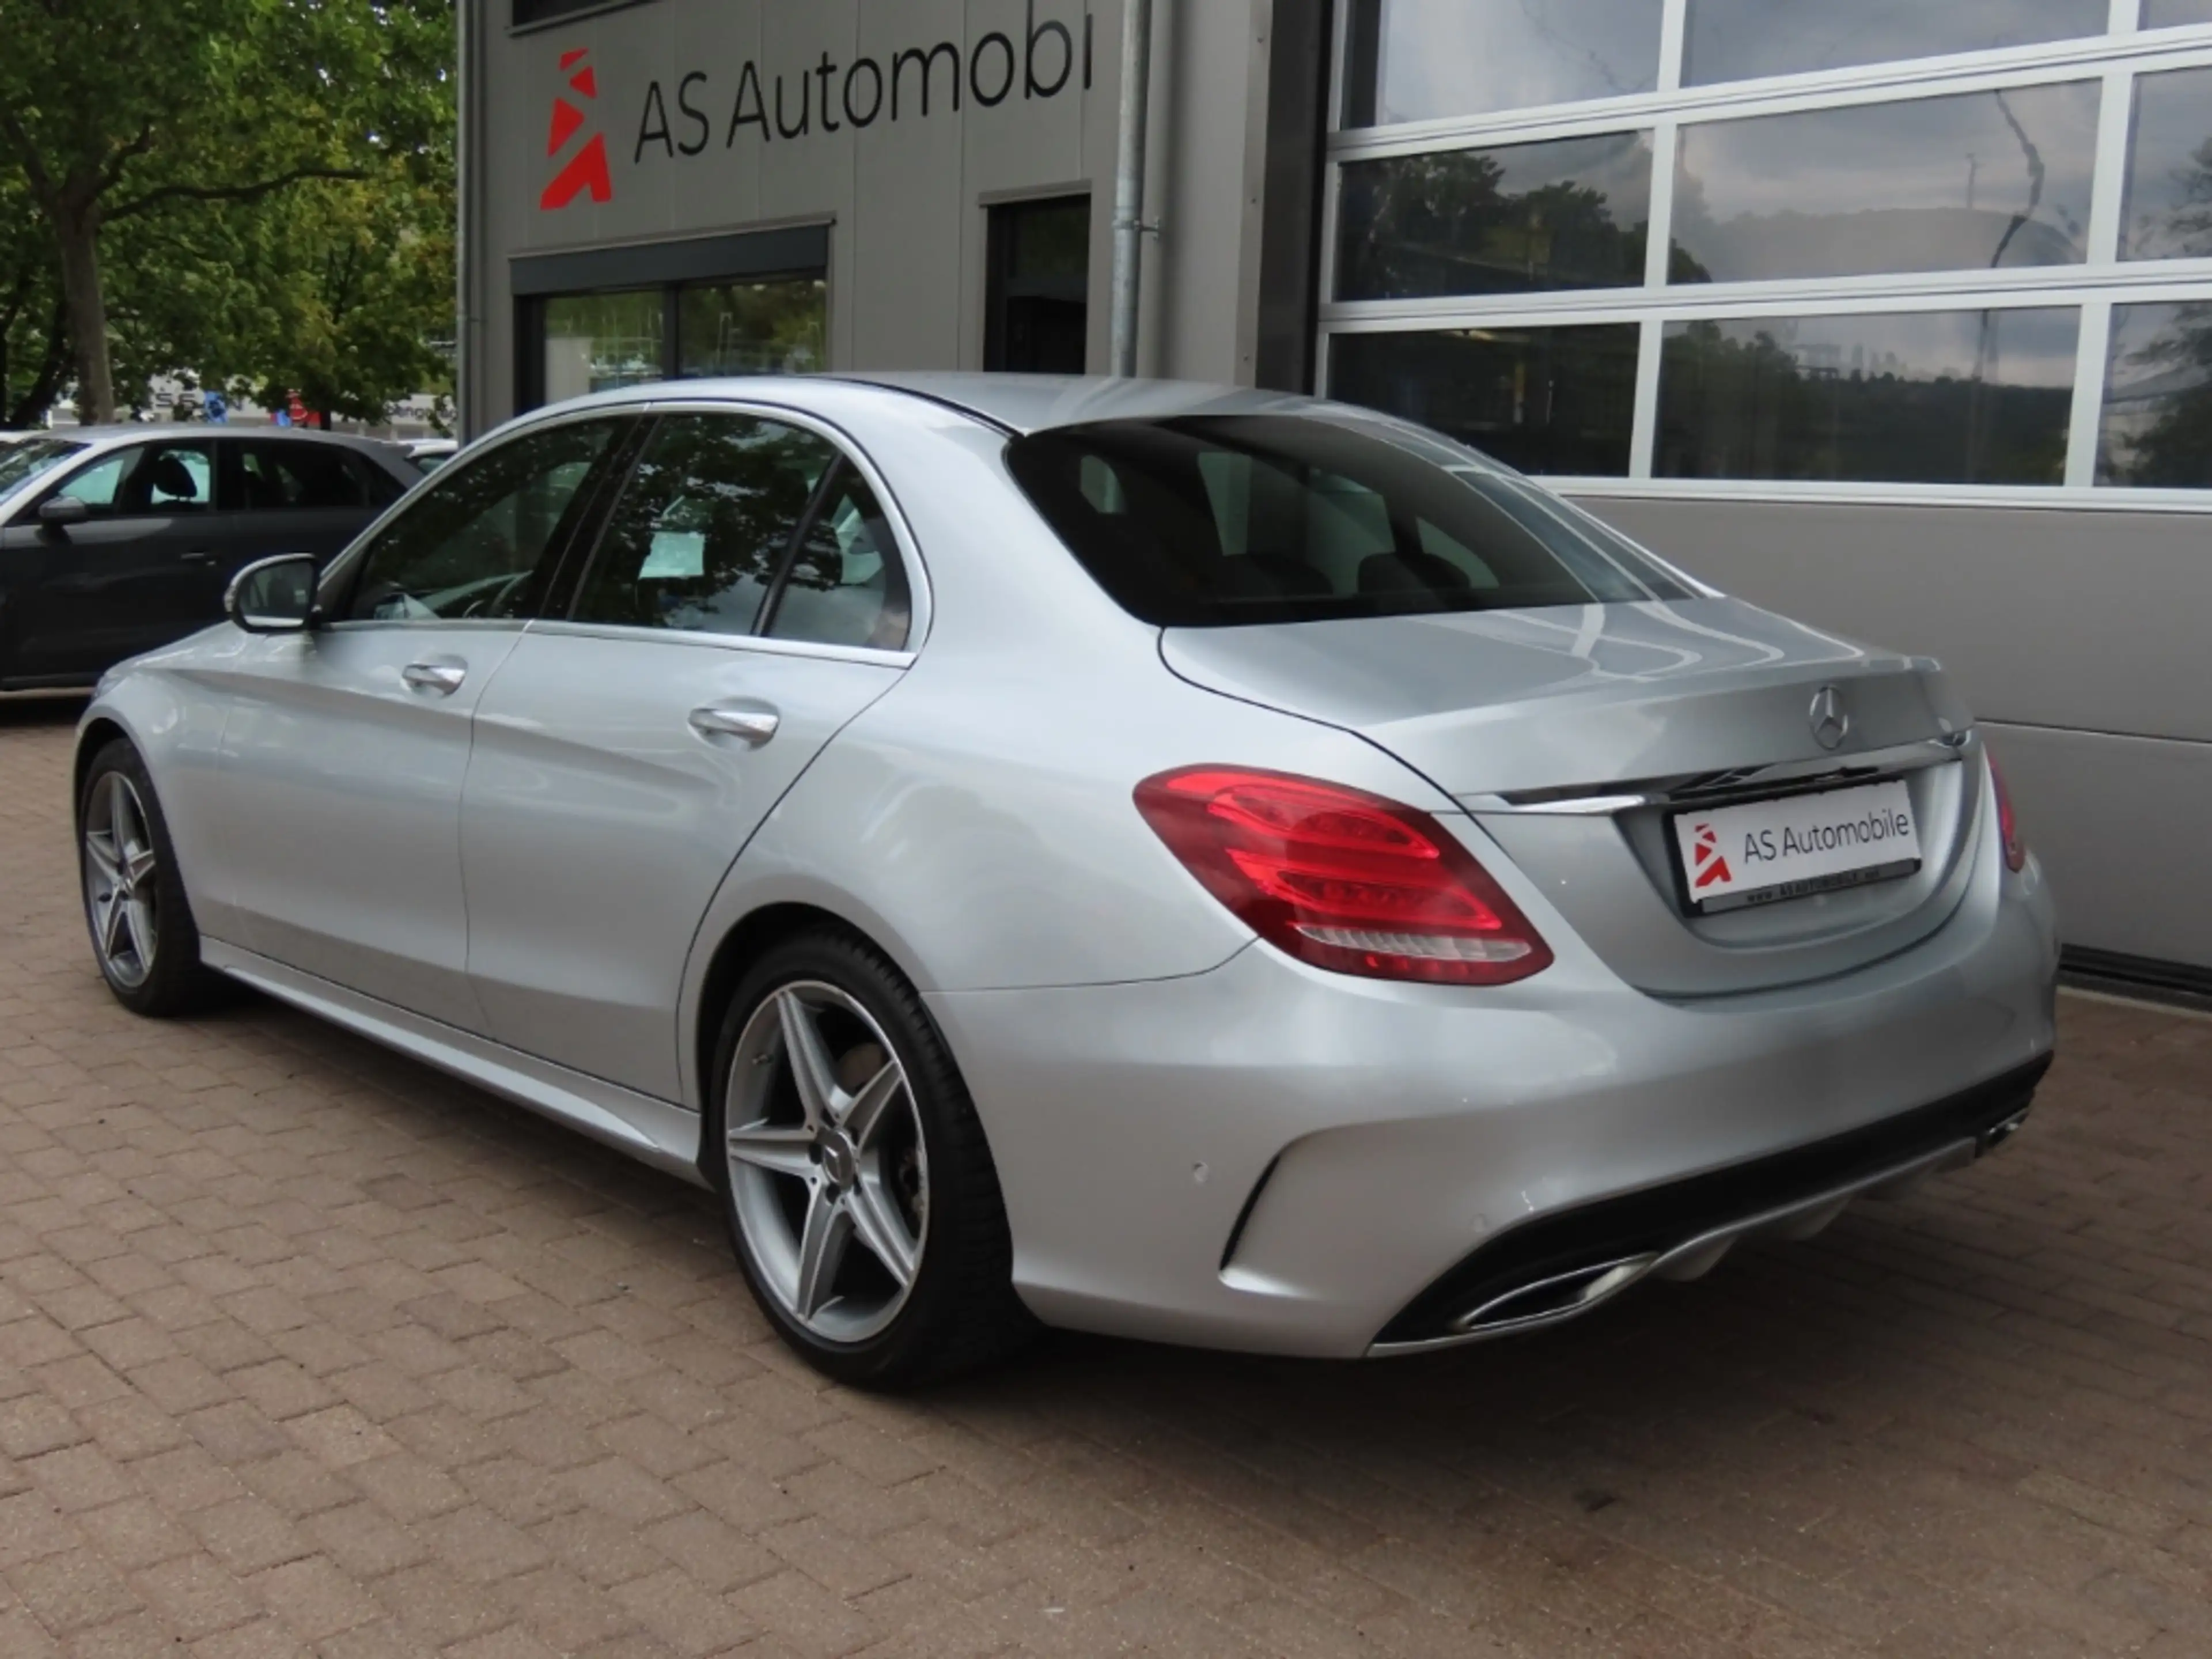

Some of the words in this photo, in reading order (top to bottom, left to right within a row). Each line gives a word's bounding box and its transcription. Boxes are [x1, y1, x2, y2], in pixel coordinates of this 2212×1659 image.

[634, 71, 710, 164] AS
[1744, 830, 1777, 863] AS
[1782, 808, 1910, 857] Automobile
